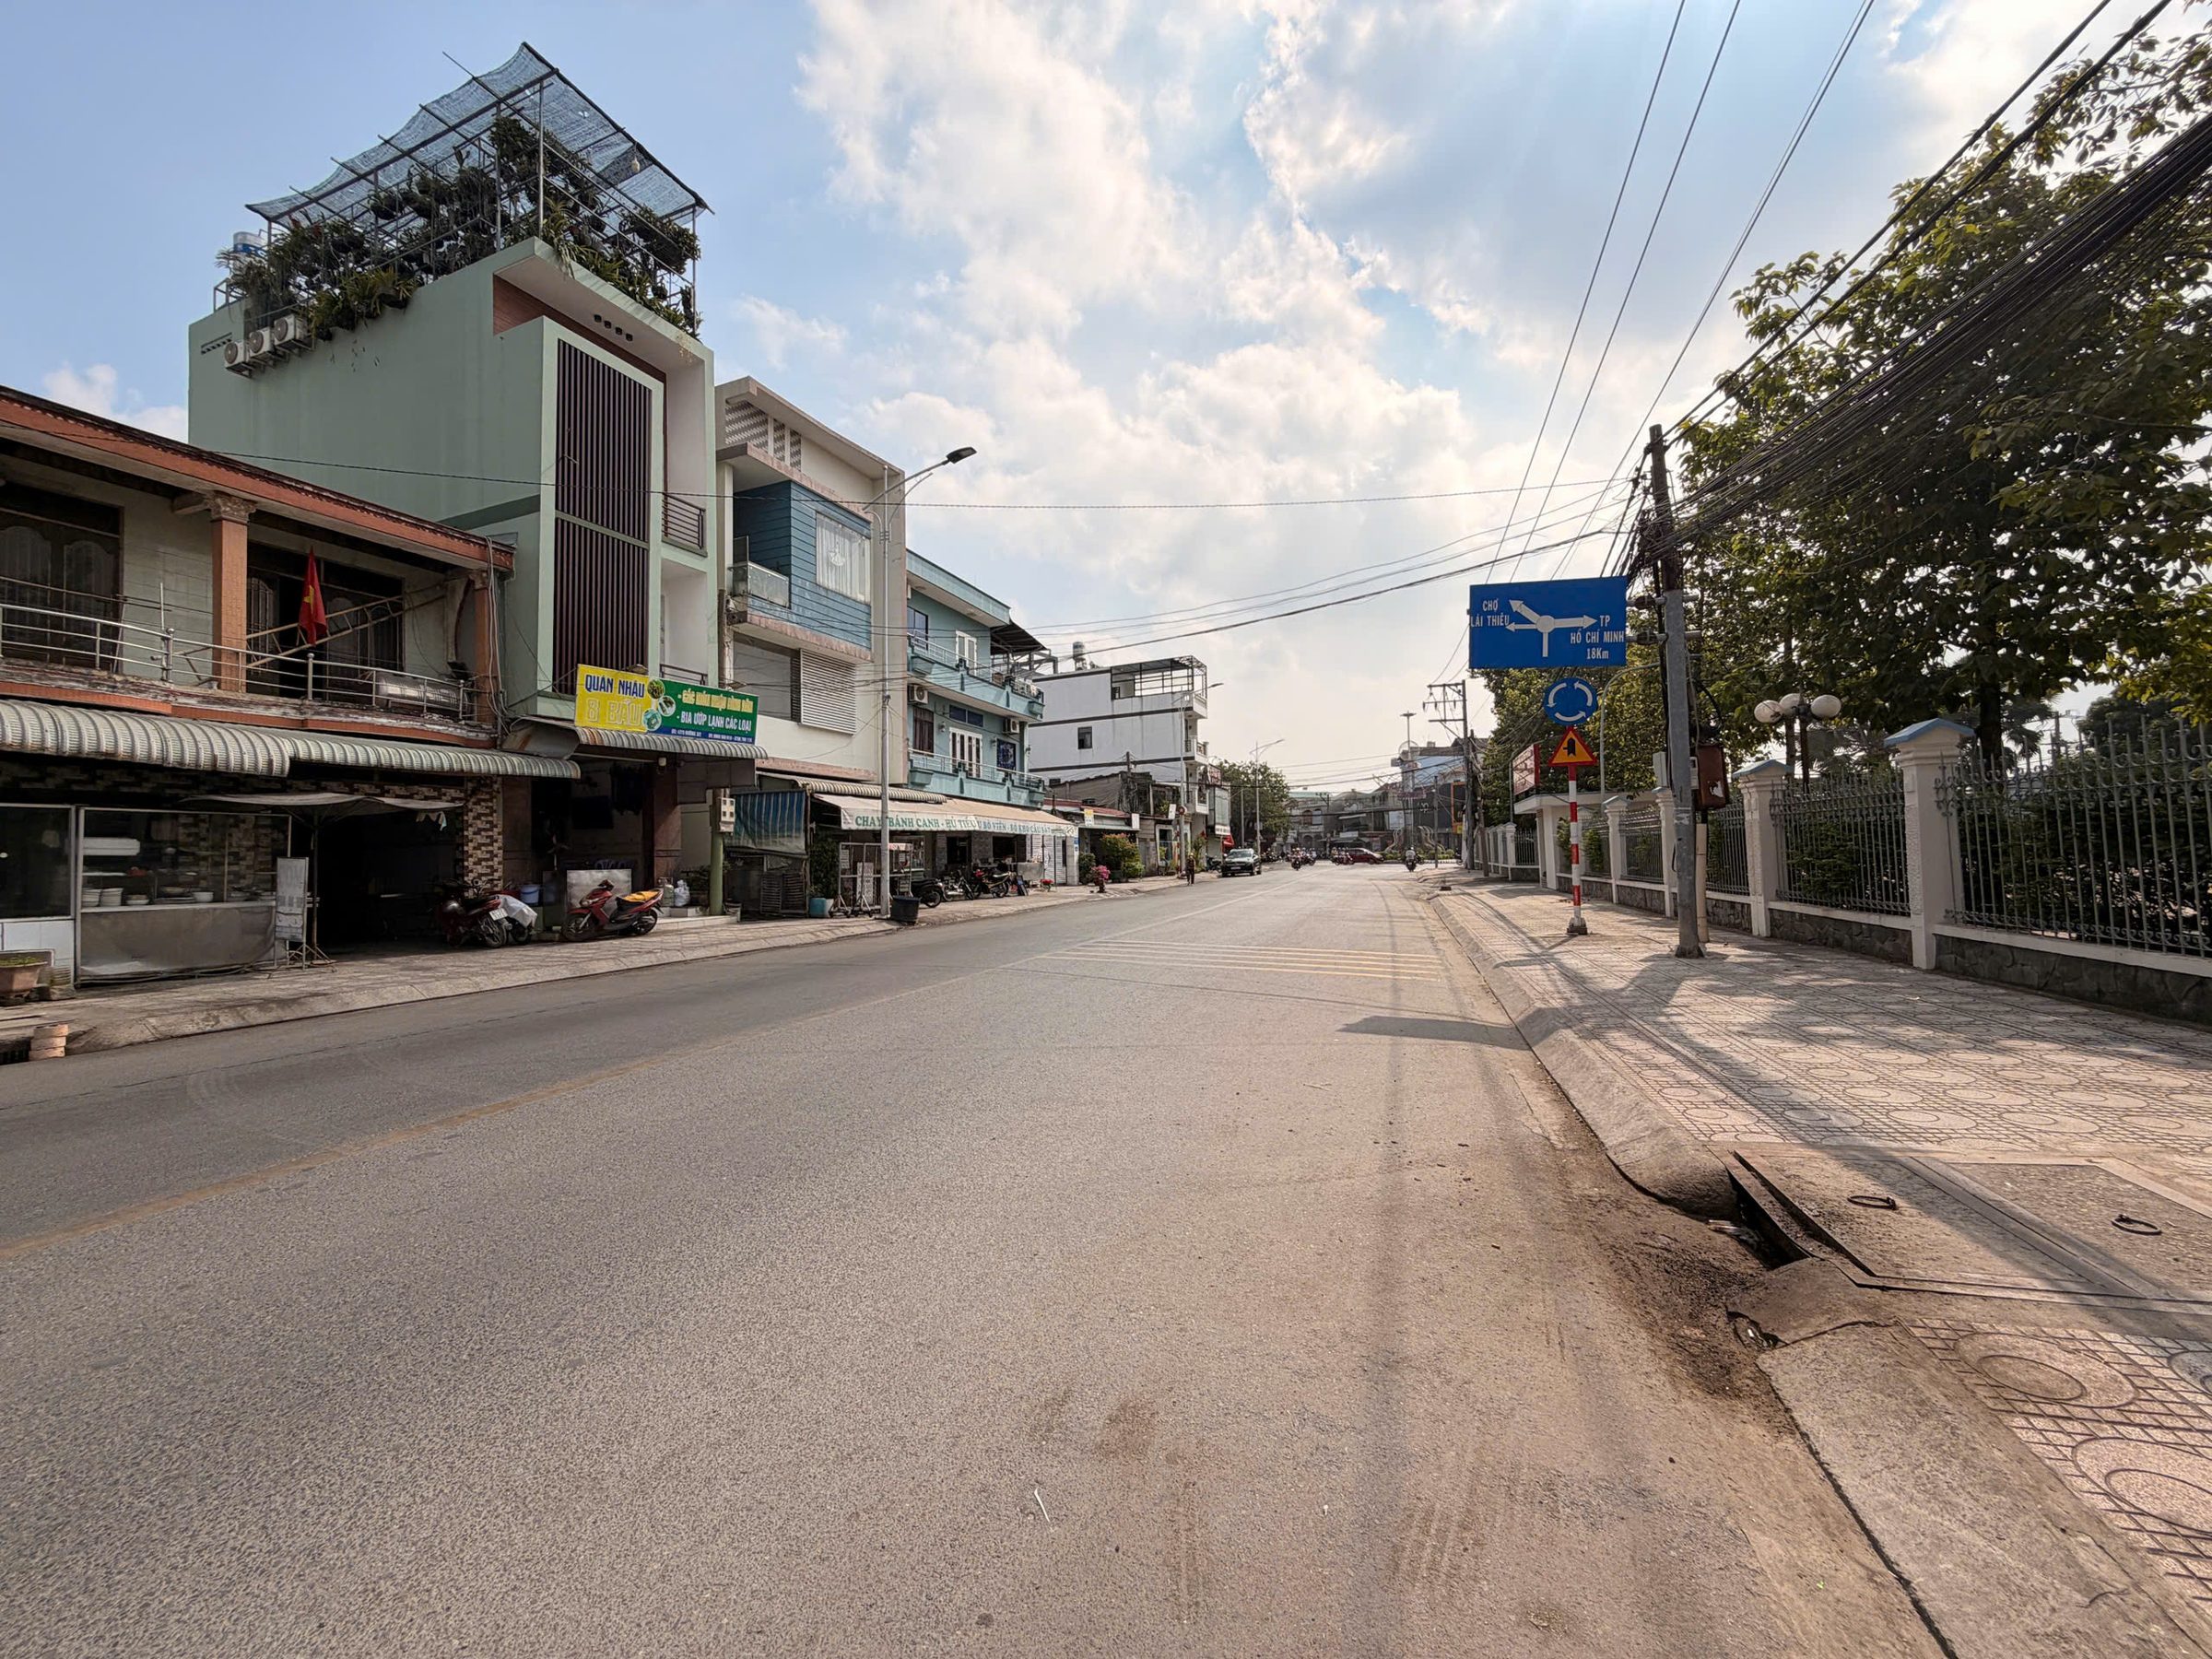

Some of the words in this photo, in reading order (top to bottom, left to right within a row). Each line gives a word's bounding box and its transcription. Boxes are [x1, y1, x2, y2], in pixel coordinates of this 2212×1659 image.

[1482, 598, 1499, 612] CHỢ
[1470, 613, 1483, 627] LÁI
[1487, 613, 1510, 627] THIÊU
[1599, 615, 1610, 627] TP
[1585, 629, 1600, 643] CHÍ
[1603, 630, 1624, 643] MINH
[1586, 647, 1609, 660] 18Km
[585, 675, 614, 693] QUÁN
[618, 679, 645, 699] NHẬU
[680, 711, 692, 724] BIA
[708, 714, 725, 730] LẠNH
[724, 715, 737, 730] CÁC
[738, 719, 752, 734] LOẠI
[888, 815, 914, 828] BÁNH
[916, 818, 940, 828] CANH
